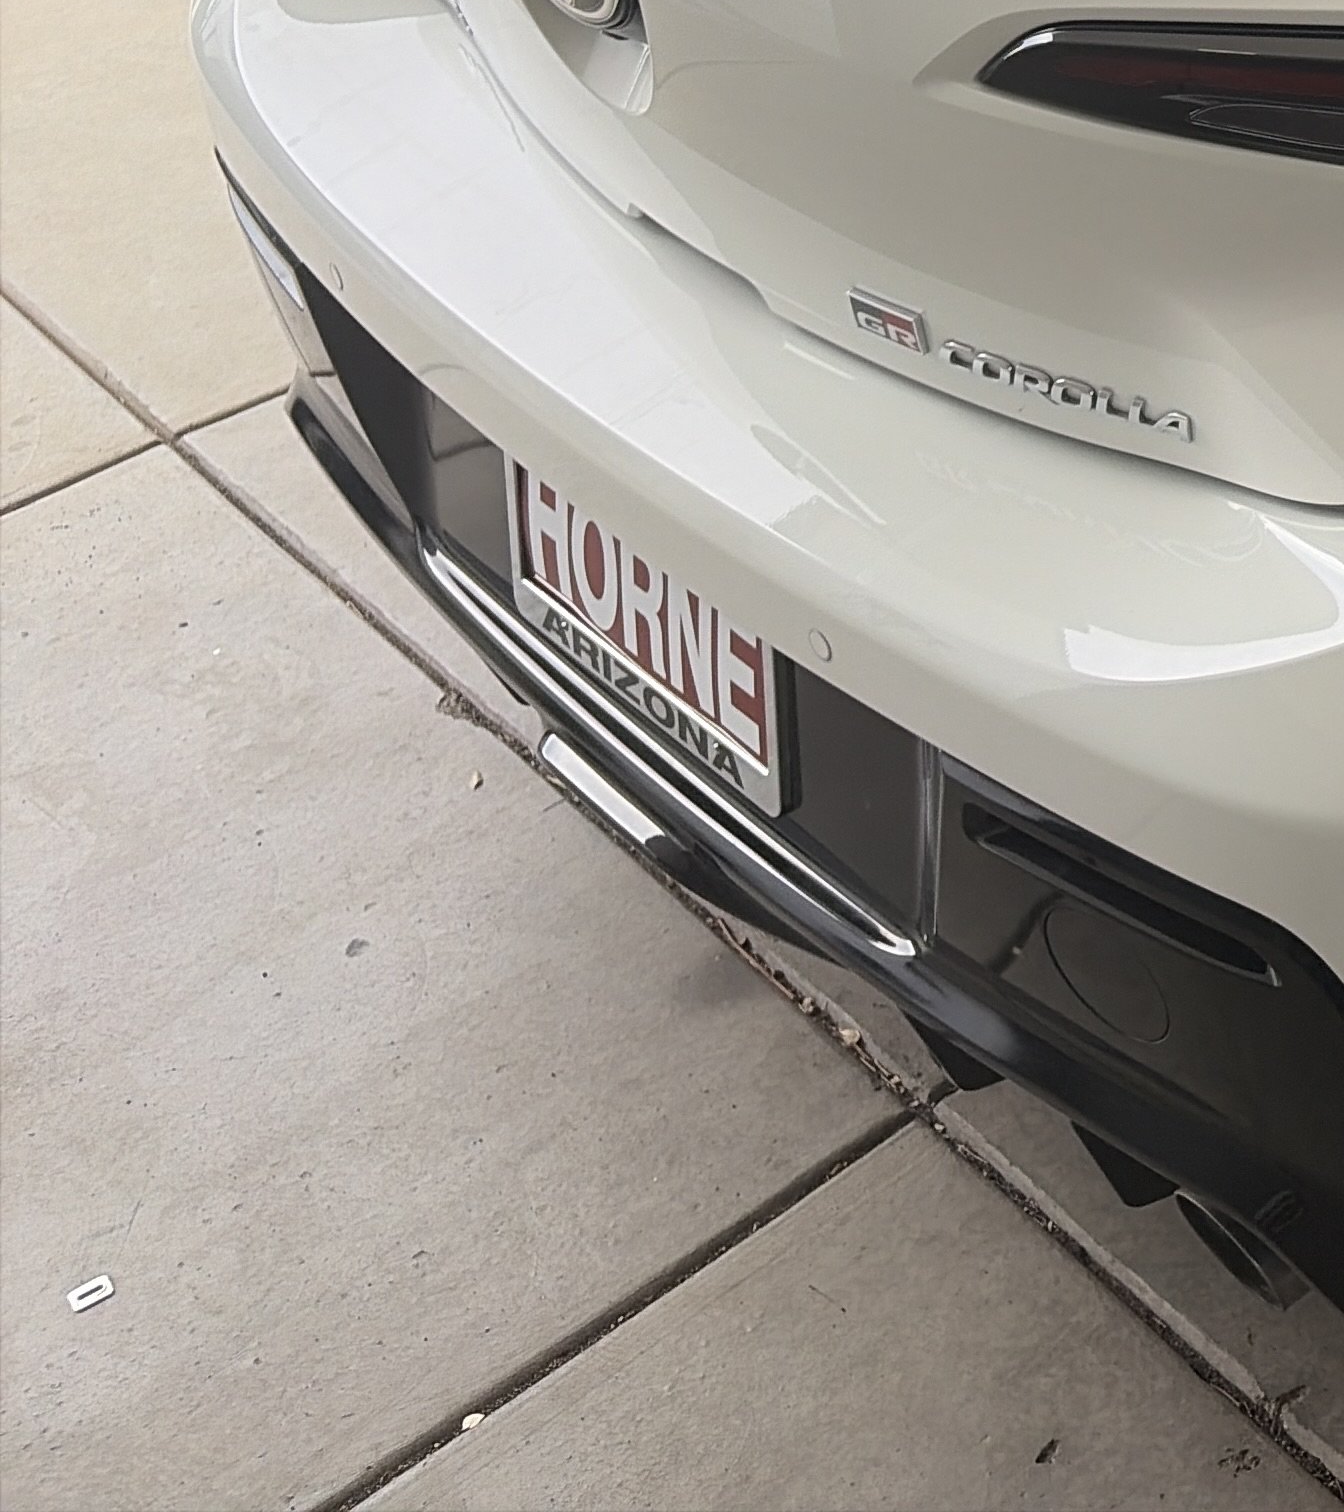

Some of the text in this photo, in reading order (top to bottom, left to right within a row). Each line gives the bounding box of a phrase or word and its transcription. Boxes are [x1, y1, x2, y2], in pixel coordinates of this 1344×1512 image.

[855, 308, 1195, 443] GR COROLLA
[527, 469, 762, 758] HORNE
[542, 606, 745, 790] ARIZONA
